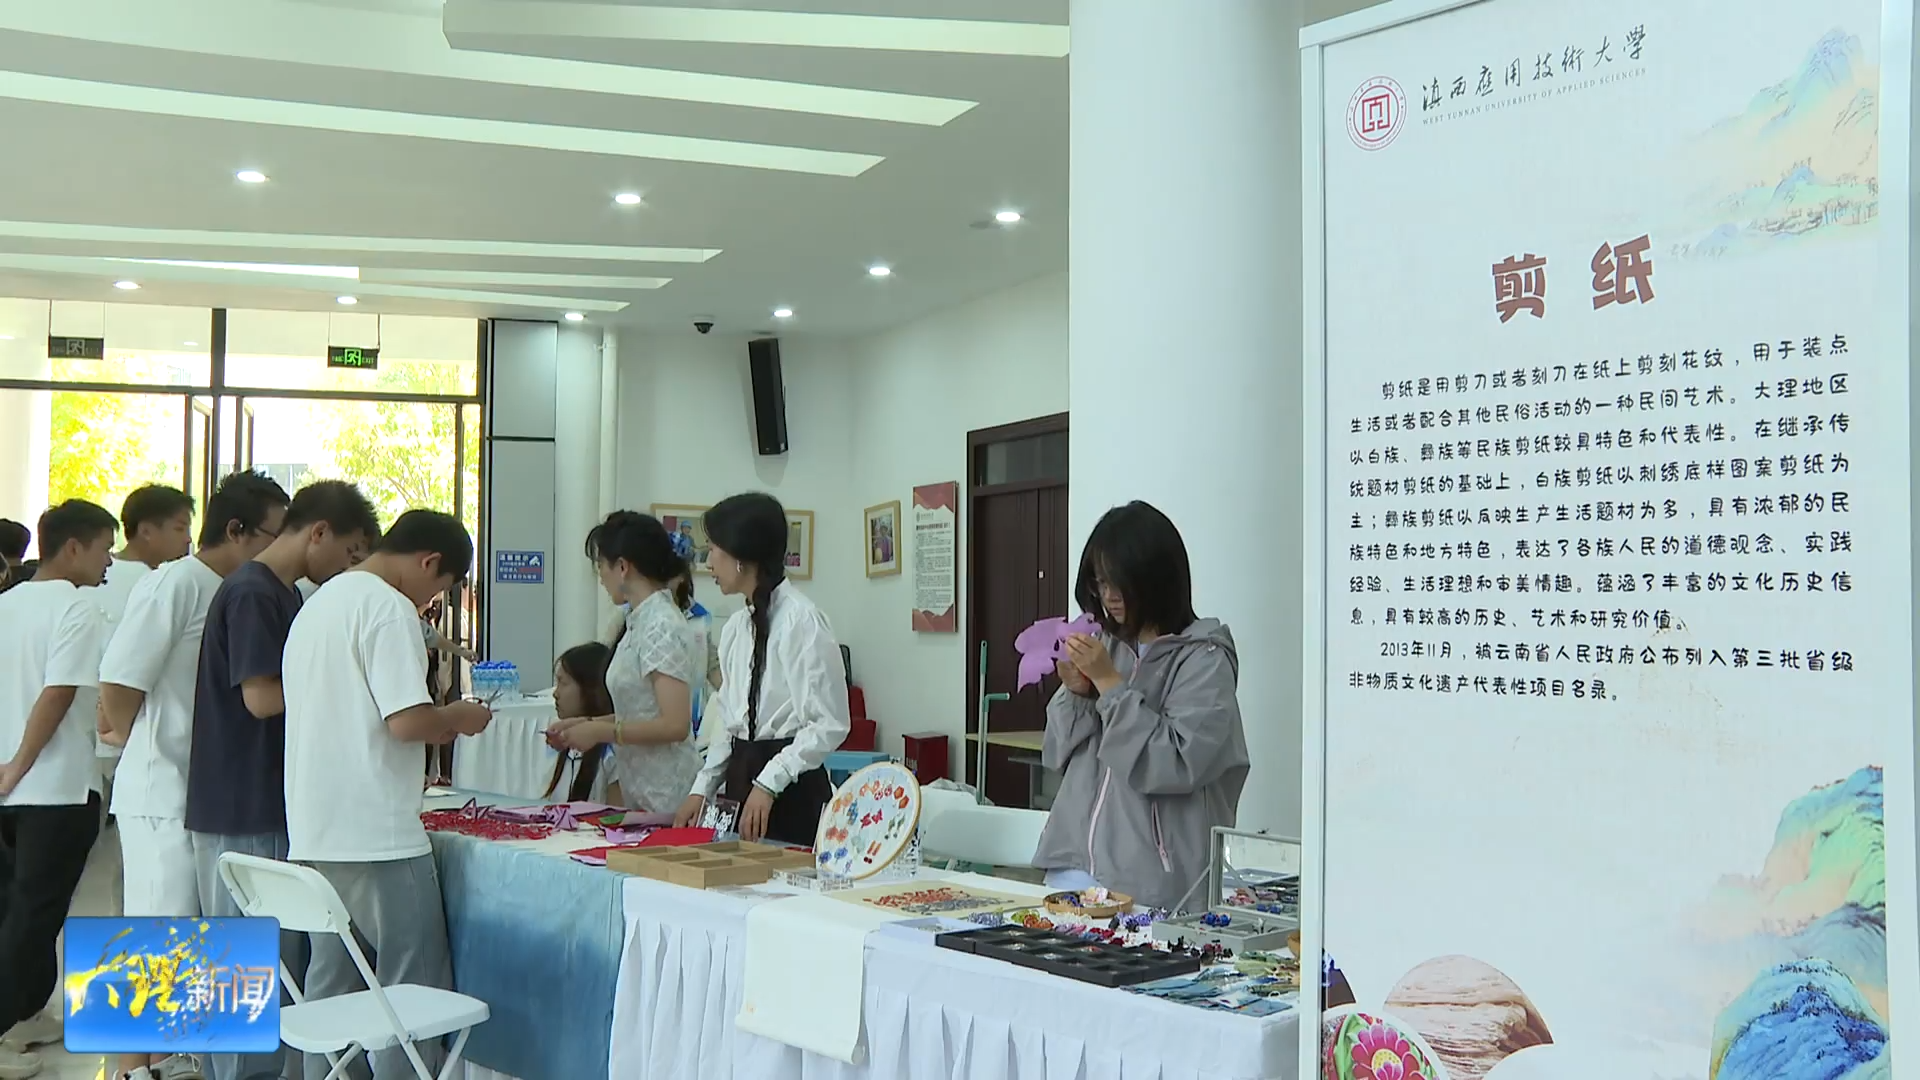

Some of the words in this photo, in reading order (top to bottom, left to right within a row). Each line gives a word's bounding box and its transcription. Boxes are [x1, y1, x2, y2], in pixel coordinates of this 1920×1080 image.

[1422, 114, 1444, 126] WEST
[1447, 106, 1481, 121] YUNNAN
[1485, 92, 1538, 112] UNIVERSITY
[1541, 88, 1553, 98] OF
[1556, 79, 1596, 96] APPLIED
[1600, 67, 1646, 85] SCIENCES
